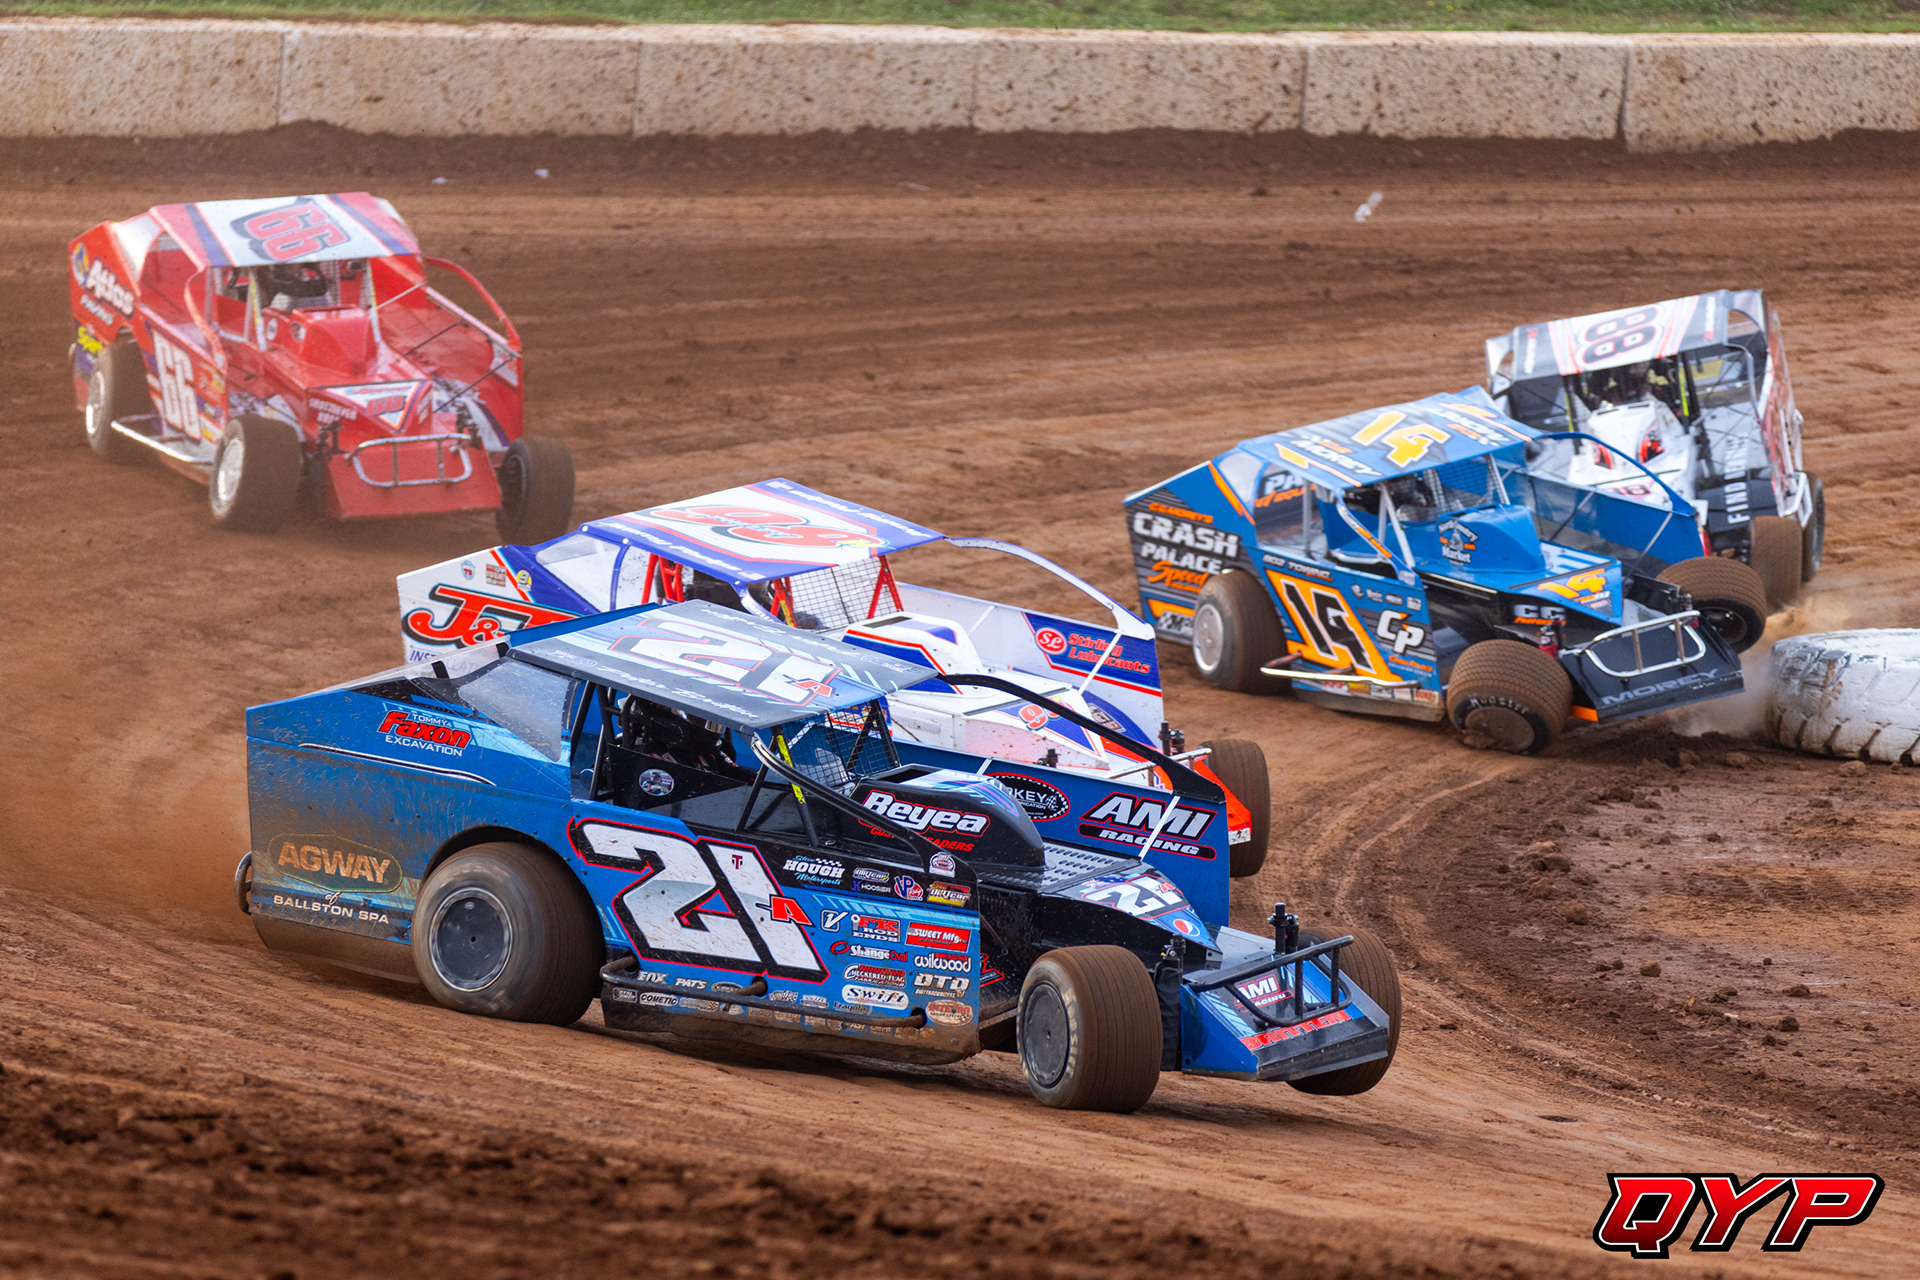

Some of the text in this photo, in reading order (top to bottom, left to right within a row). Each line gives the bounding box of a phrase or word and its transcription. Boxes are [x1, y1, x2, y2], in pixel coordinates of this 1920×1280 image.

[236, 198, 350, 263] 66
[1580, 305, 1660, 364] 88
[153, 329, 201, 441] 66
[367, 395, 406, 416] 66
[1350, 410, 1452, 470] 14
[1133, 511, 1239, 558] CRASH
[1141, 541, 1222, 575] PALACE
[1147, 559, 1209, 587] Speed
[1537, 568, 1607, 600] 14
[1278, 578, 1378, 675] 14
[1376, 610, 1425, 654] CP
[1068, 632, 1123, 657] Stirling
[1600, 668, 1718, 706] MOREY
[379, 710, 472, 750] Faxon
[411, 713, 448, 726] TOMMY
[385, 734, 463, 757] EXCAVATION
[862, 791, 987, 833] Reyea
[1090, 795, 1210, 838] AMI
[870, 826, 975, 852] CUS ADERS
[1098, 829, 1201, 856] RACING
[278, 841, 391, 884] AGWAY
[783, 859, 846, 879] HOUGH
[793, 872, 842, 886] Motorsports
[861, 884, 892, 893] HOOSIER
[894, 875, 914, 898] VP
[273, 894, 390, 924] BALLSTON SPA
[325, 892, 341, 905] of
[858, 917, 899, 931] FK
[863, 928, 899, 936] ROD
[913, 928, 942, 939] SWEET
[852, 932, 898, 942] ENDS
[844, 964, 886, 980] CHECKERED
[914, 953, 972, 973] wilwood
[638, 971, 668, 984] FOX
[675, 978, 708, 989] PAT'S
[914, 973, 970, 991] DTD
[640, 994, 678, 1006] COMETIC
[846, 986, 905, 1003] Swift
[1254, 992, 1286, 1007] ACING
[833, 1001, 868, 1013] Fragola
[928, 1003, 970, 1015] INTERA
[1240, 1009, 1352, 1051] BRITTEN
